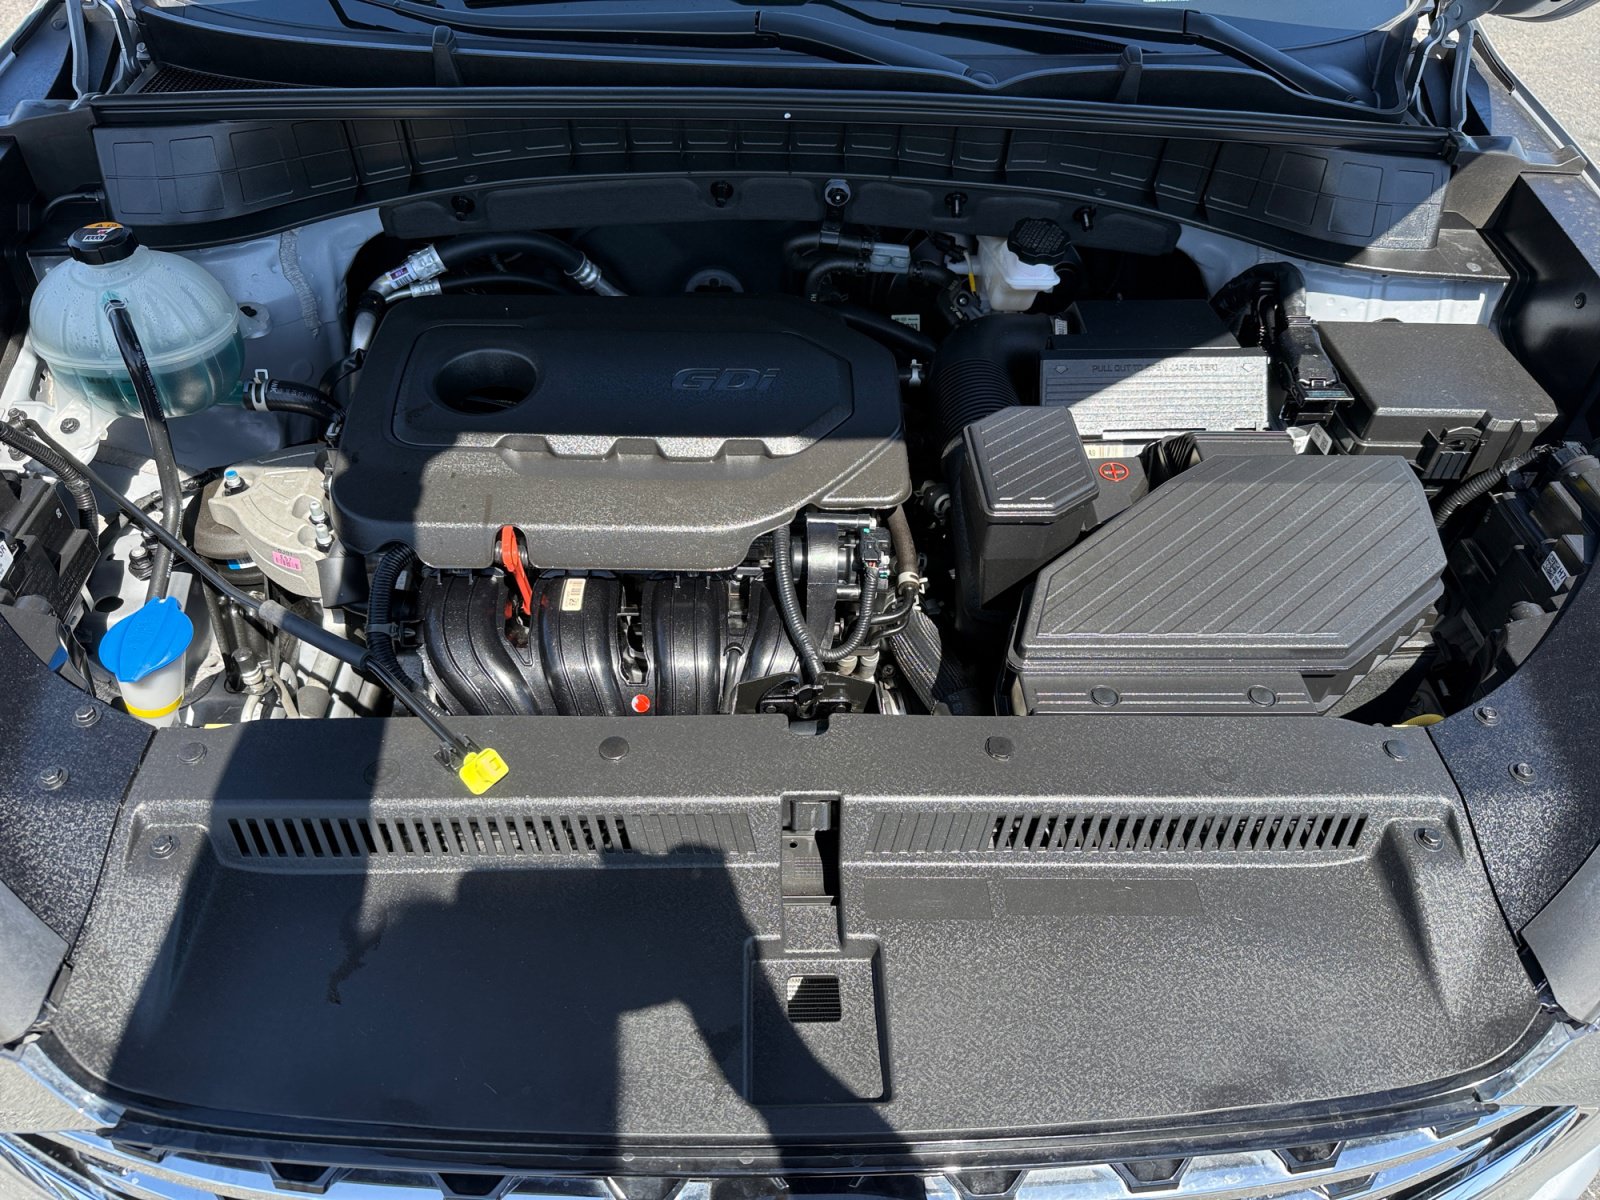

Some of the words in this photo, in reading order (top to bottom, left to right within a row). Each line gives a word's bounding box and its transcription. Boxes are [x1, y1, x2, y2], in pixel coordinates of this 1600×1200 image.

[1092, 364, 1113, 373] PULL
[1114, 364, 1131, 372] OUT
[671, 367, 781, 391] GDi
